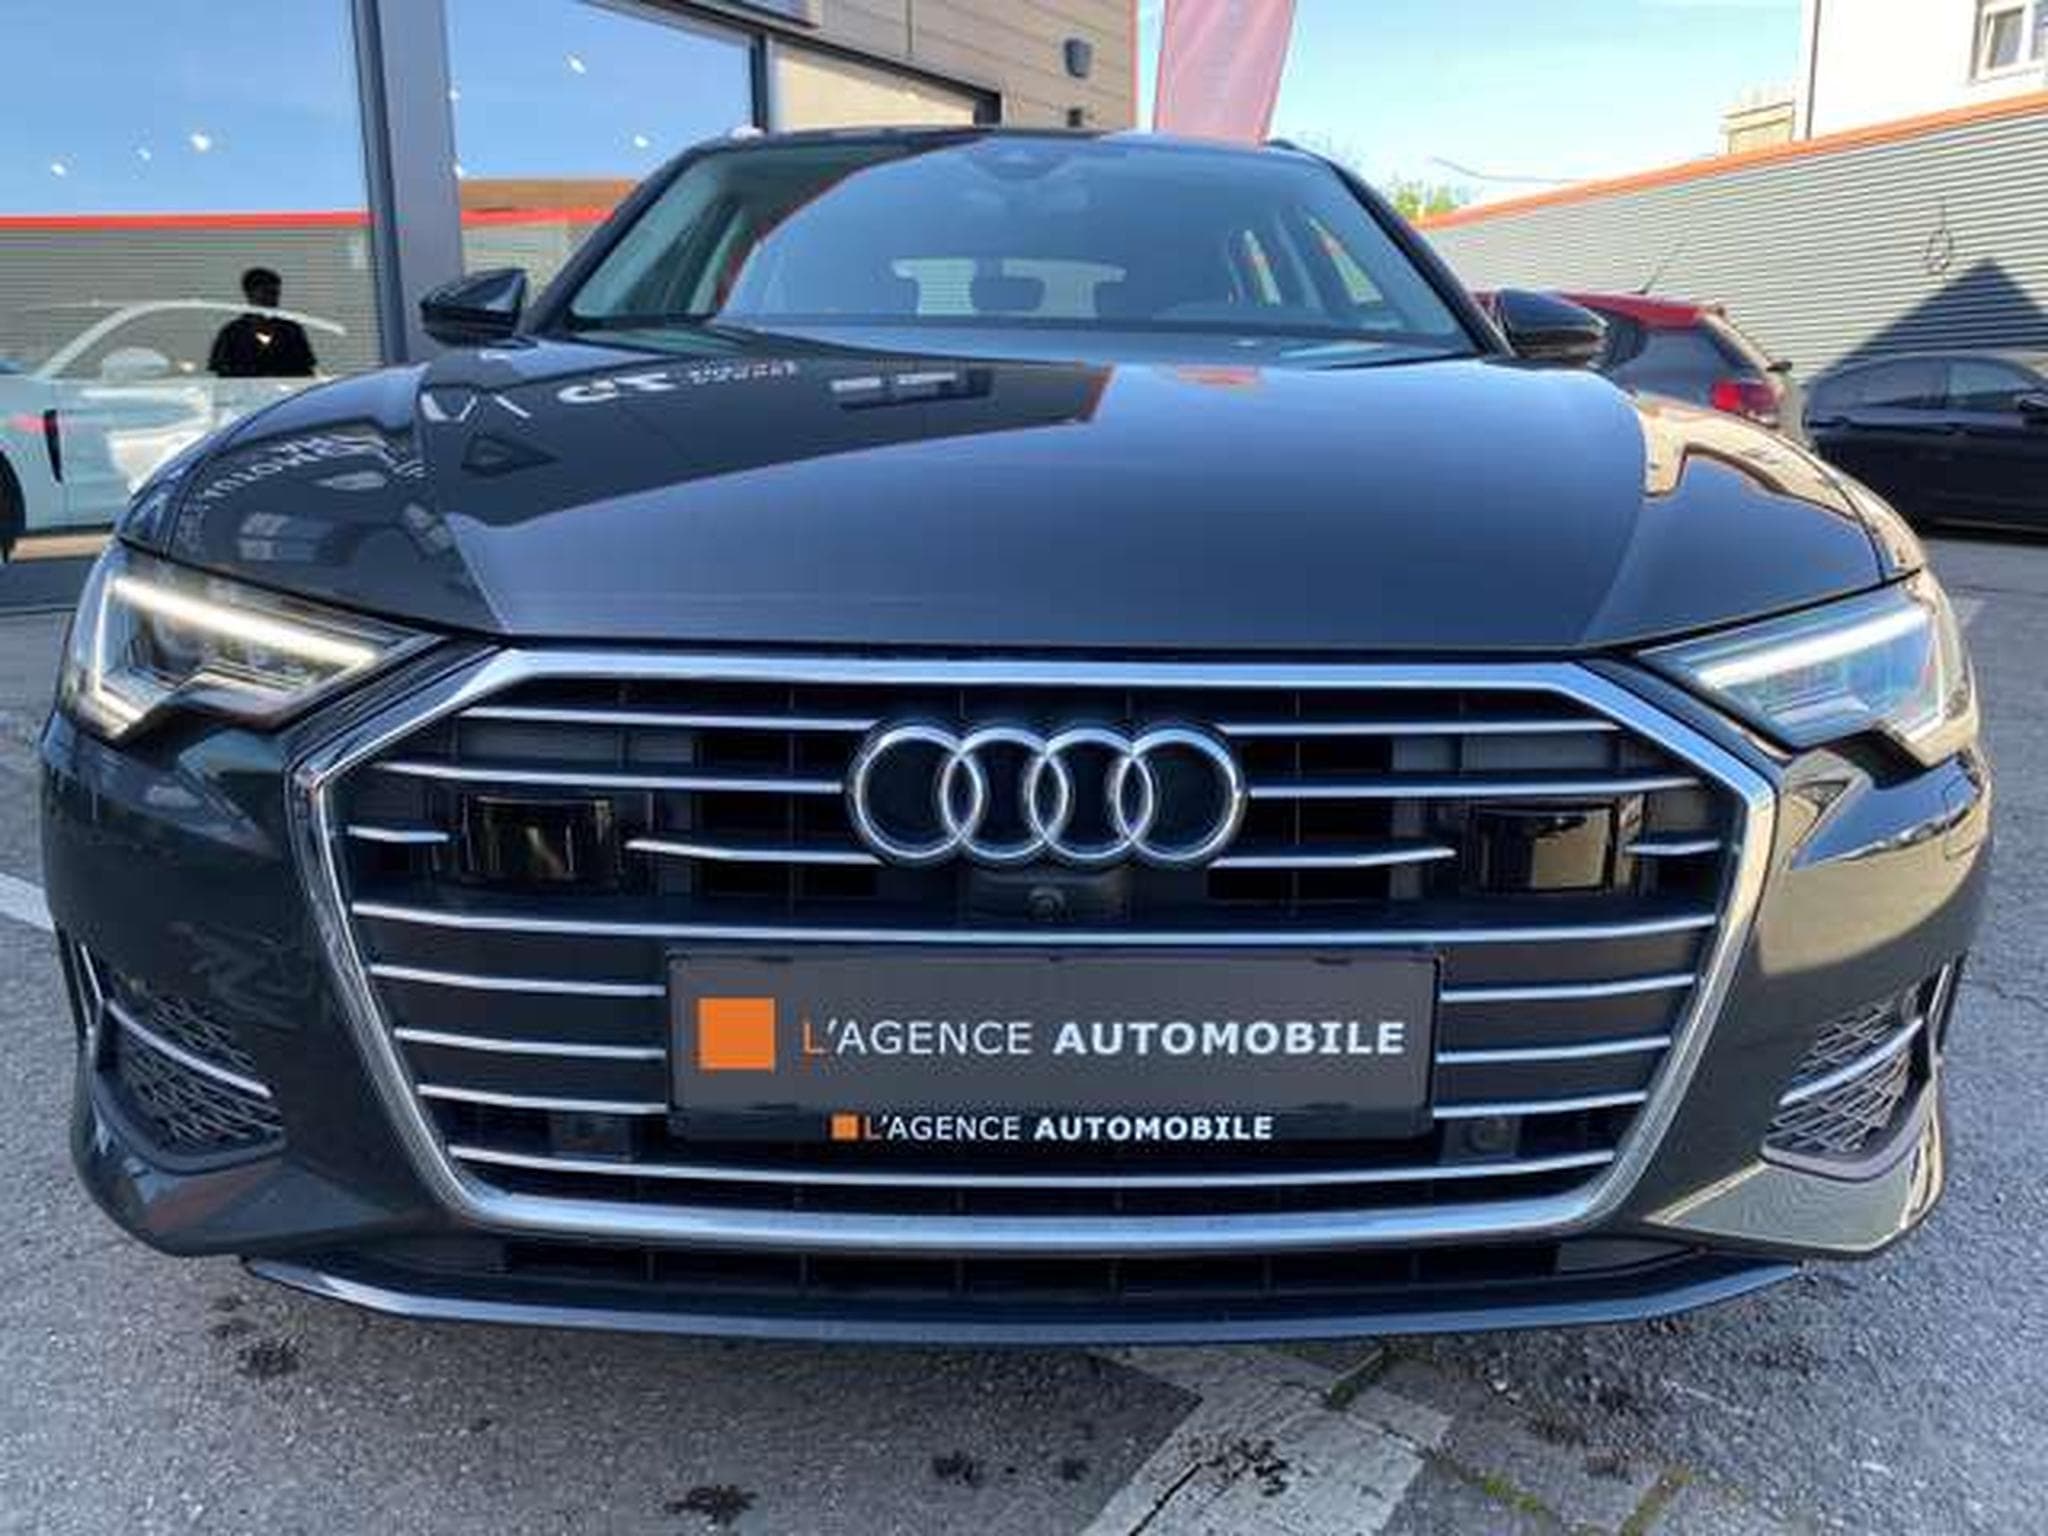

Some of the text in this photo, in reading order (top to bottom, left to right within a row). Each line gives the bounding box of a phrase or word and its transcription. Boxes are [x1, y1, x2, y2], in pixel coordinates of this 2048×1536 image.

[803, 1018, 1406, 1055] L'AGENCE AUTOMOBILE
[864, 1115, 1274, 1141] L'AGENCE AUTOMOBILE
